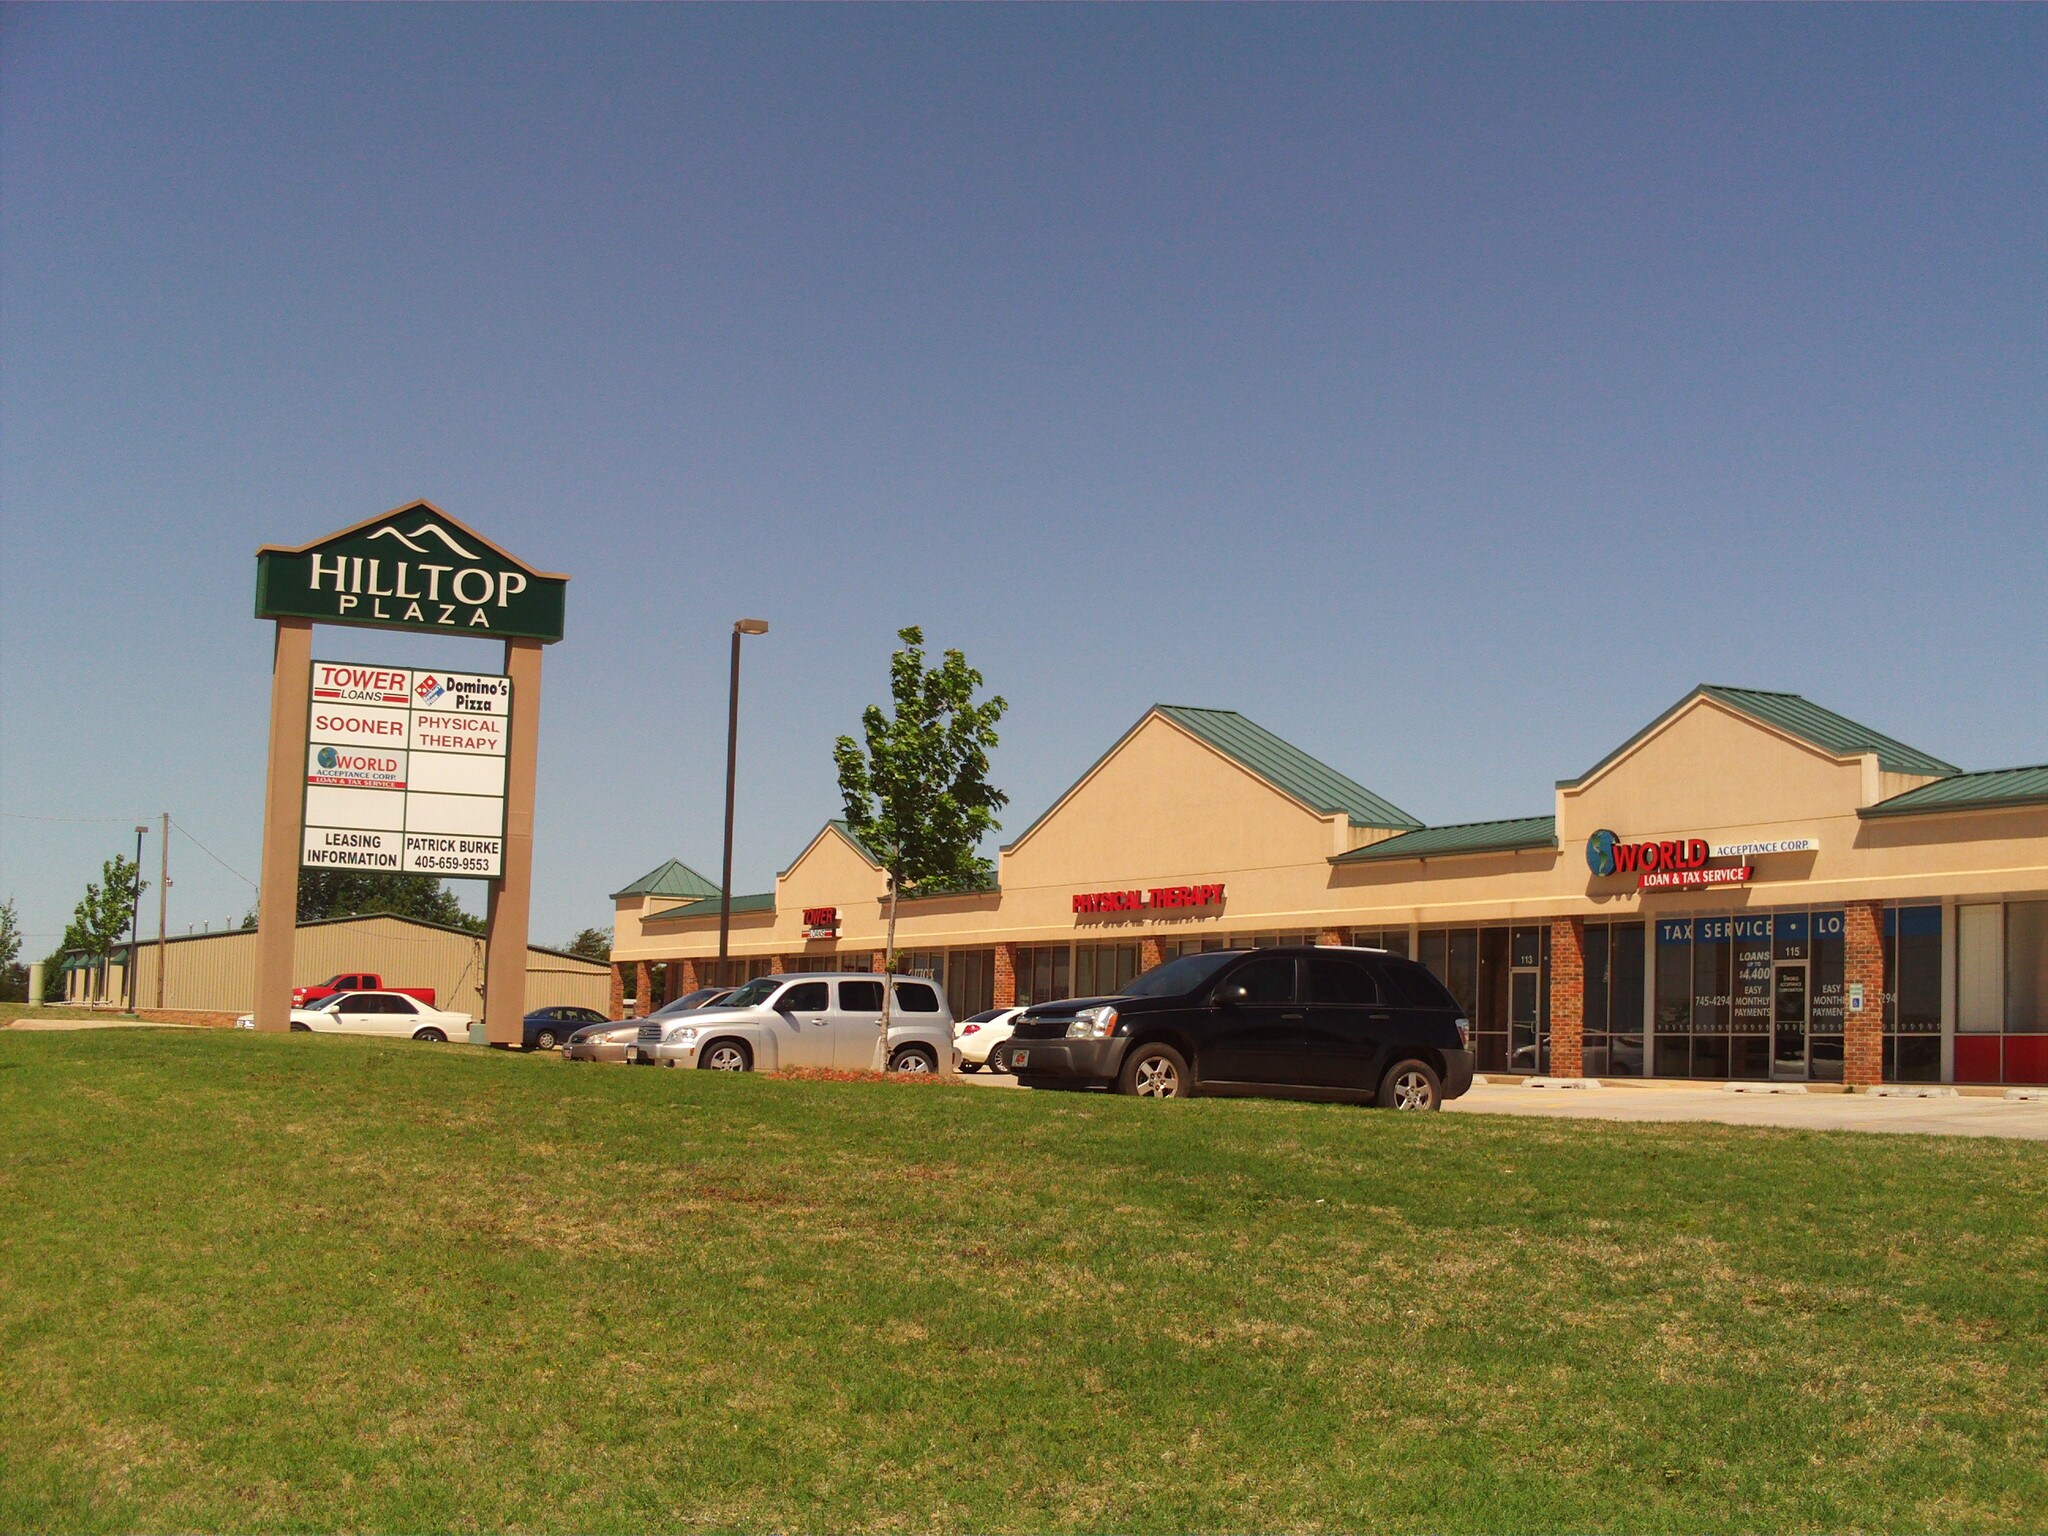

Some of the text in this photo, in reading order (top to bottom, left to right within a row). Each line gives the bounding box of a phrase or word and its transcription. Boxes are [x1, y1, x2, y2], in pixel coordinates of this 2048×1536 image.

[310, 553, 527, 607] HILLTOP
[339, 594, 490, 628] PLAZA
[321, 667, 406, 691] TOWER
[446, 677, 507, 696] Domino's
[340, 689, 382, 701] LOANS
[456, 694, 491, 711] Pizza
[316, 715, 404, 736] SOONER
[418, 716, 500, 733] PHYSICAL
[419, 734, 498, 750] THERAPY
[336, 755, 398, 772] WORLD
[316, 769, 369, 779] ACCEPTANCE
[364, 780, 395, 788] SERVICE
[325, 833, 381, 848] LEASING
[407, 837, 499, 855] PATRICK BURKE
[1717, 840, 1809, 856] ACCEPTANCE CORP.
[307, 849, 397, 867] INFORMATION
[414, 855, 489, 871] 405-659-9553
[1612, 838, 1709, 872] WORLD
[1643, 867, 1744, 887] LOAN & TAX SERVICE
[1072, 883, 1225, 913] PHYSICAL THERAPY
[802, 907, 836, 926] TOWER
[1664, 917, 1845, 940] TAX SERVICE LO
[1521, 955, 1533, 964] 113
[1739, 951, 1771, 962] LOANS
[1785, 946, 1800, 957] 115
[1744, 985, 1762, 995] EASY
[1822, 984, 1842, 994] EASY
[1695, 995, 1731, 1007] 745-4294
[1735, 996, 1771, 1006] MONTHLY
[1734, 1008, 1771, 1017] PAYMENTS
